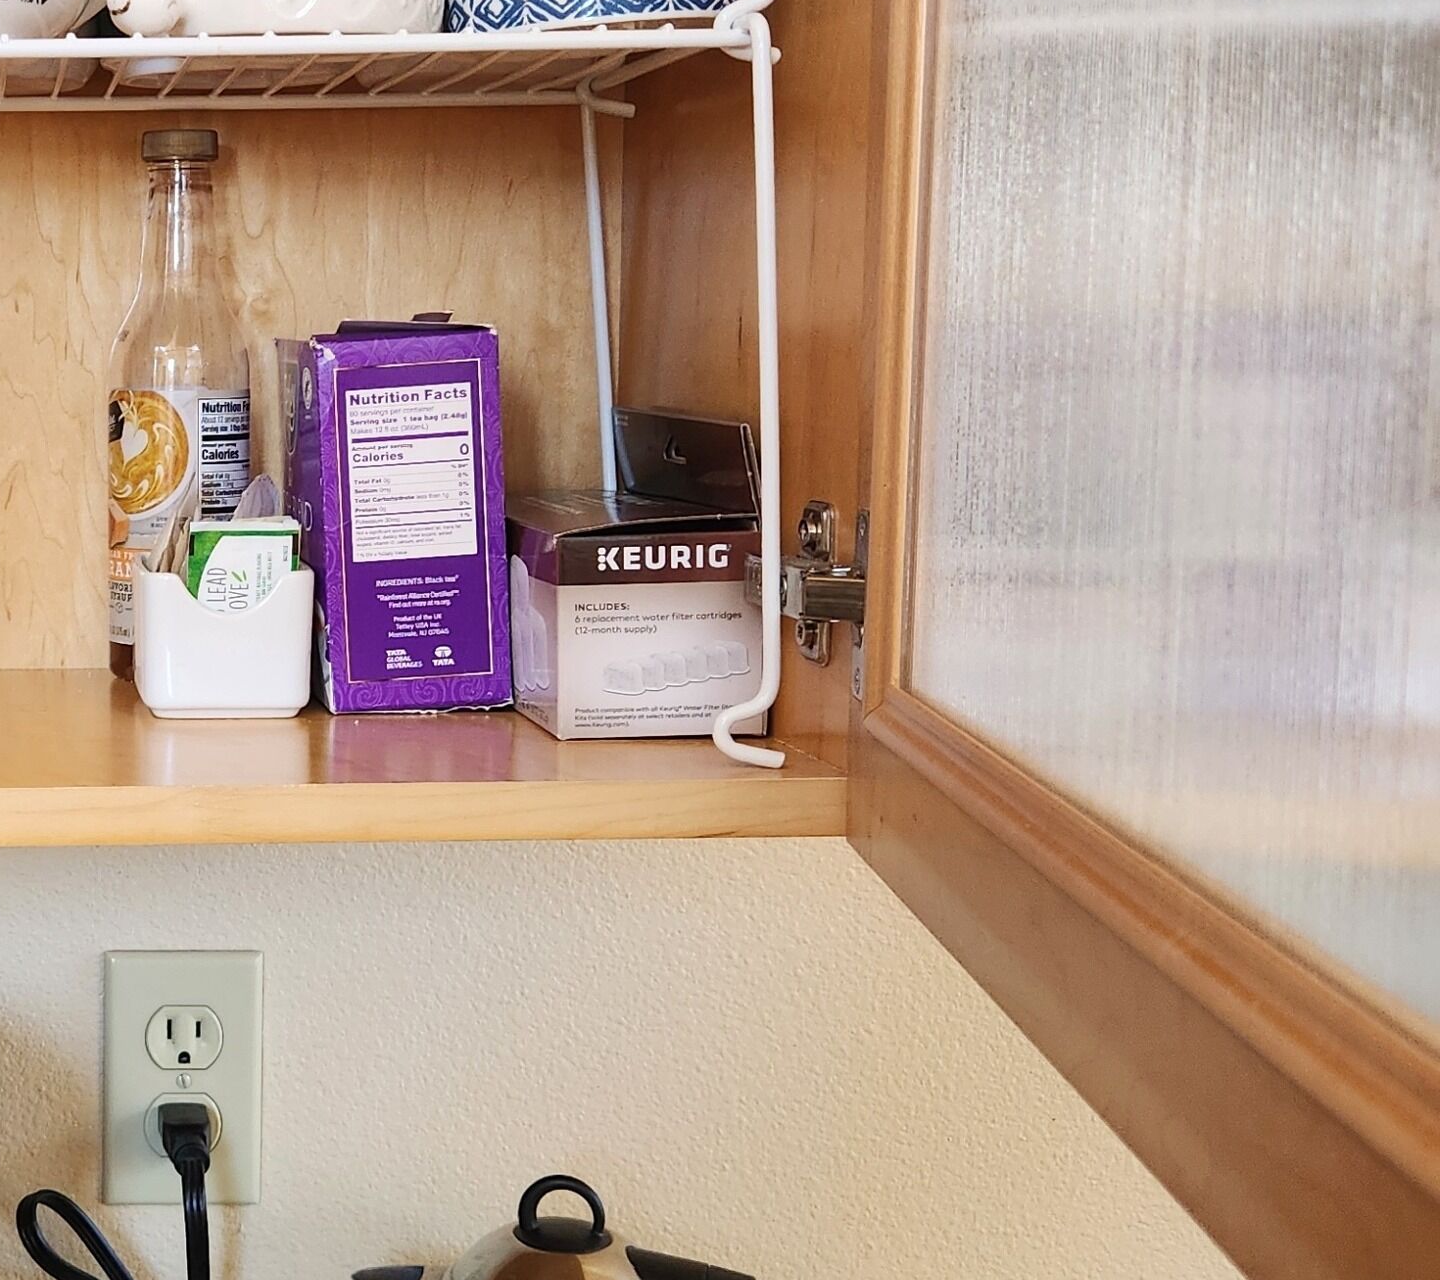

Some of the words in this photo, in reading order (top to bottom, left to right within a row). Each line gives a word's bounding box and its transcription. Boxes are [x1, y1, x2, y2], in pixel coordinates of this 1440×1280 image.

[350, 392, 420, 406] Nutrition
[424, 388, 467, 400] Facts
[202, 402, 242, 414] Nutrition
[202, 449, 240, 460] Calories
[352, 452, 404, 463] Calories
[460, 443, 469, 456] 0
[597, 544, 730, 571] KEURIG
[207, 567, 228, 602] LEAD
[376, 578, 424, 587] INGREDIENTS:
[424, 576, 444, 584] Black
[229, 583, 248, 610] OVE
[574, 602, 630, 612] INCLUDES:
[574, 616, 580, 624] 6
[582, 614, 644, 625] replacement
[646, 613, 670, 622] water
[671, 612, 693, 620] filter
[696, 610, 742, 622] cartridges
[574, 624, 622, 636] (12-month
[624, 624, 658, 635] supply)
[386, 661, 423, 670] BEVERAGES
[432, 658, 456, 666] TATA
